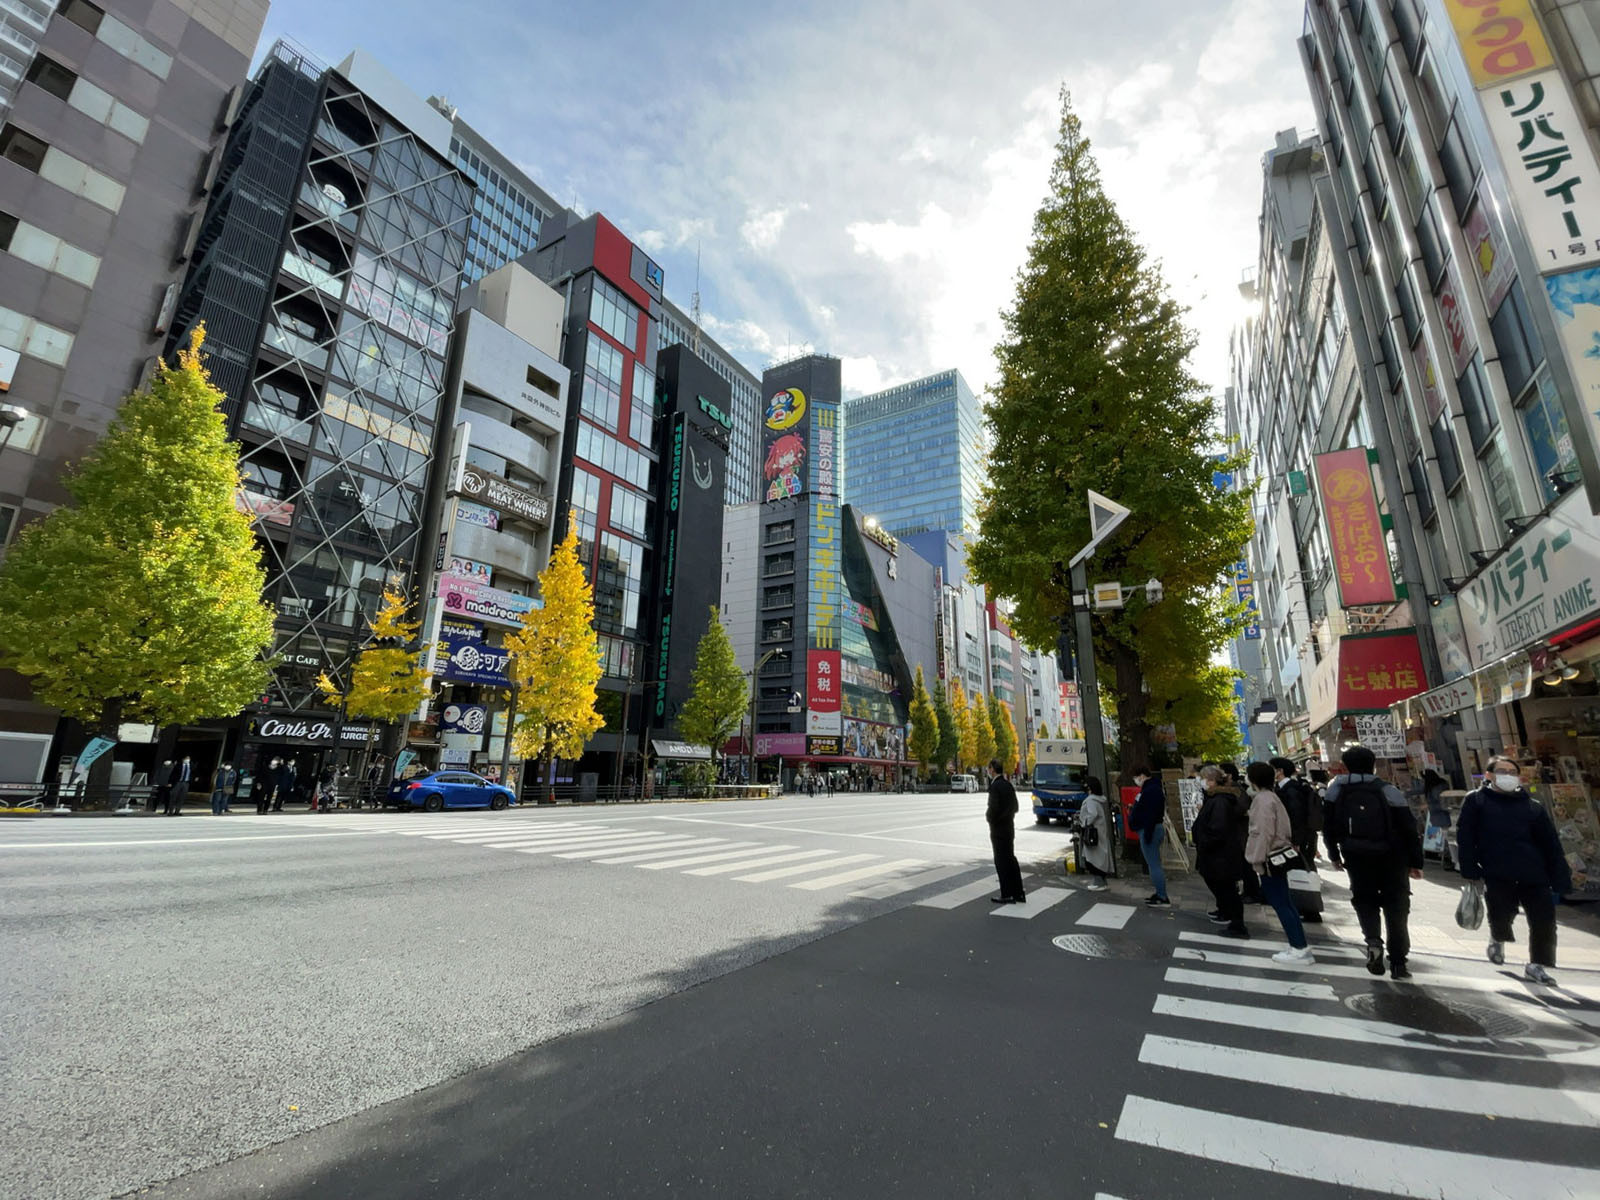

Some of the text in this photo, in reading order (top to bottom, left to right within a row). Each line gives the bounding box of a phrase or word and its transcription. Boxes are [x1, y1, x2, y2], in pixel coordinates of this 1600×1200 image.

[1500, 81, 1582, 239] リバティー
[697, 394, 732, 430] TSU
[670, 423, 683, 511] TSUKUMO
[767, 485, 802, 500] ISLAND
[769, 478, 800, 491] AKIBA
[487, 489, 512, 503] MEAT
[513, 499, 548, 519] WINERY
[1471, 528, 1573, 625] リバティー
[1500, 602, 1548, 650] LIBERTY
[1553, 577, 1597, 624] ANIME
[296, 654, 320, 666] CAFE
[437, 640, 450, 651] 2F
[1477, 636, 1498, 661] アニメ
[656, 614, 671, 716] TSUKUMO
[818, 660, 831, 691] 免税
[260, 719, 334, 740] Carl's Jr.
[756, 738, 772, 755] 8F
